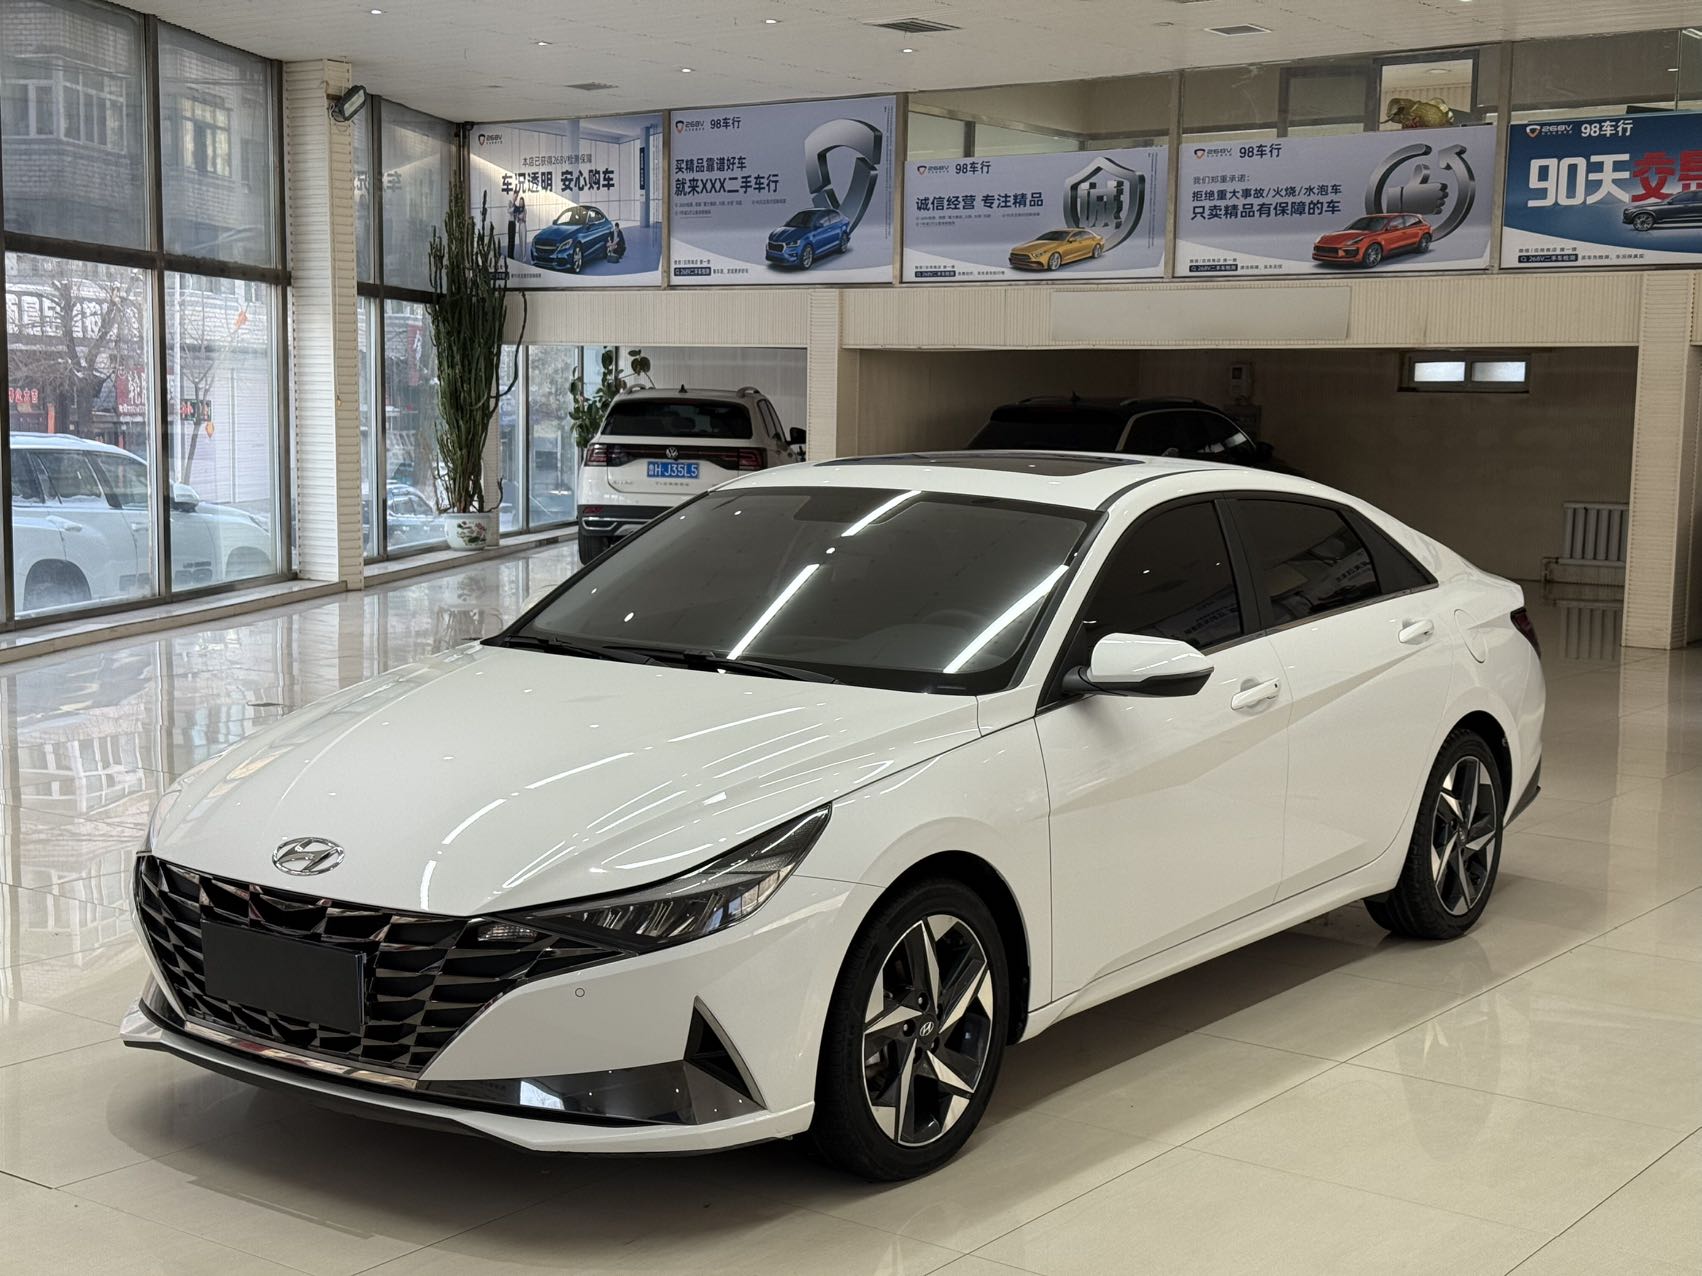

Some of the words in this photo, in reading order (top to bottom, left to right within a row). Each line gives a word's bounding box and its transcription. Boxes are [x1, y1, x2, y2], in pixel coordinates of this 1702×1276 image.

[710, 116, 741, 130] 98车行
[1541, 124, 1573, 132] 268V
[1581, 119, 1633, 137] 98车行
[1239, 143, 1282, 159] 98车行
[675, 155, 747, 175] 买精品靠谱好车
[955, 160, 991, 175] 98车行
[501, 171, 553, 195] 车况透明
[560, 167, 615, 192] 安心购车
[674, 174, 779, 197] 就来XXX二手车行
[915, 194, 976, 212] 诚信经营
[981, 191, 1044, 210] 专注精品
[1191, 183, 1342, 202] 拒绝重大事故/火烧/水泡车
[1190, 199, 1342, 221] 只卖精品有保障的车
